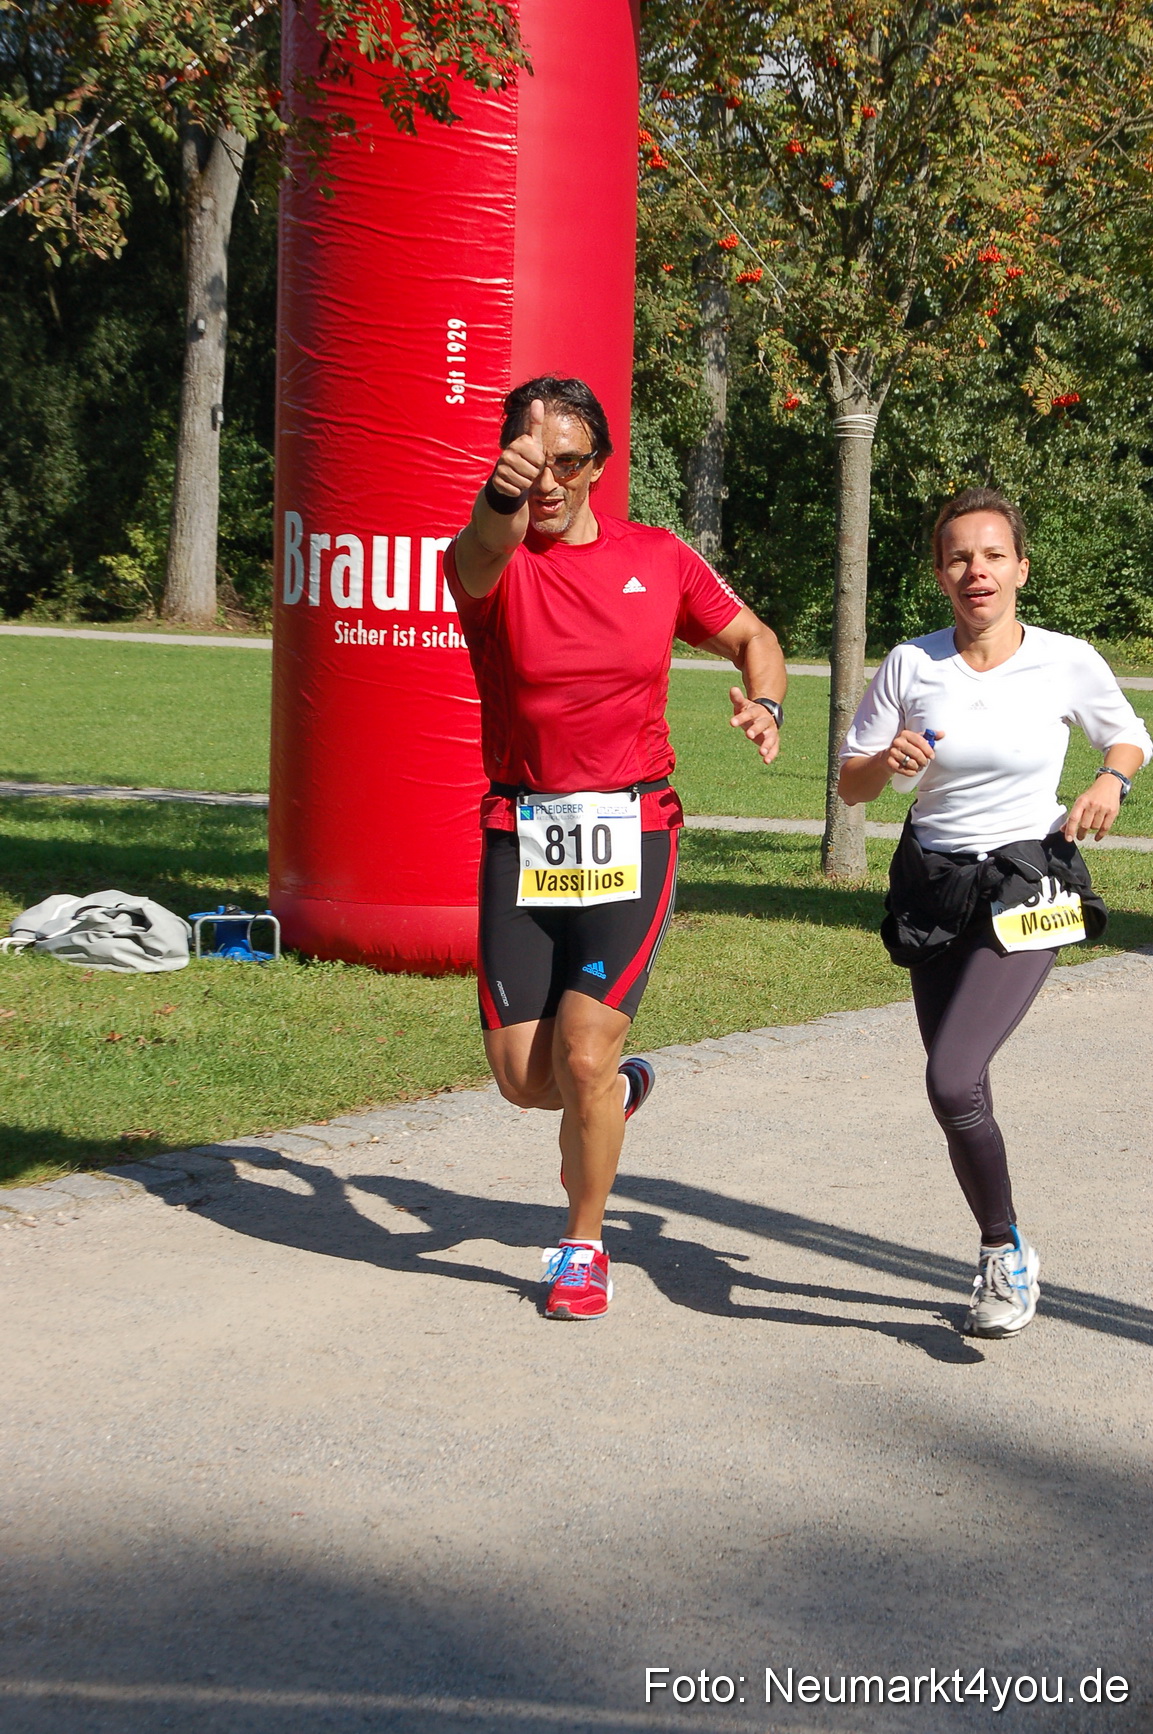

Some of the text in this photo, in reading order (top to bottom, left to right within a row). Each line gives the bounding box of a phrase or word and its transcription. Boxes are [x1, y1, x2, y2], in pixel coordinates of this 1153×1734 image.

[445, 318, 467, 404] Seit 1929
[334, 619, 388, 646] Sicher
[392, 624, 416, 647] ist
[545, 824, 612, 866] 810
[535, 870, 624, 891] Vassilios
